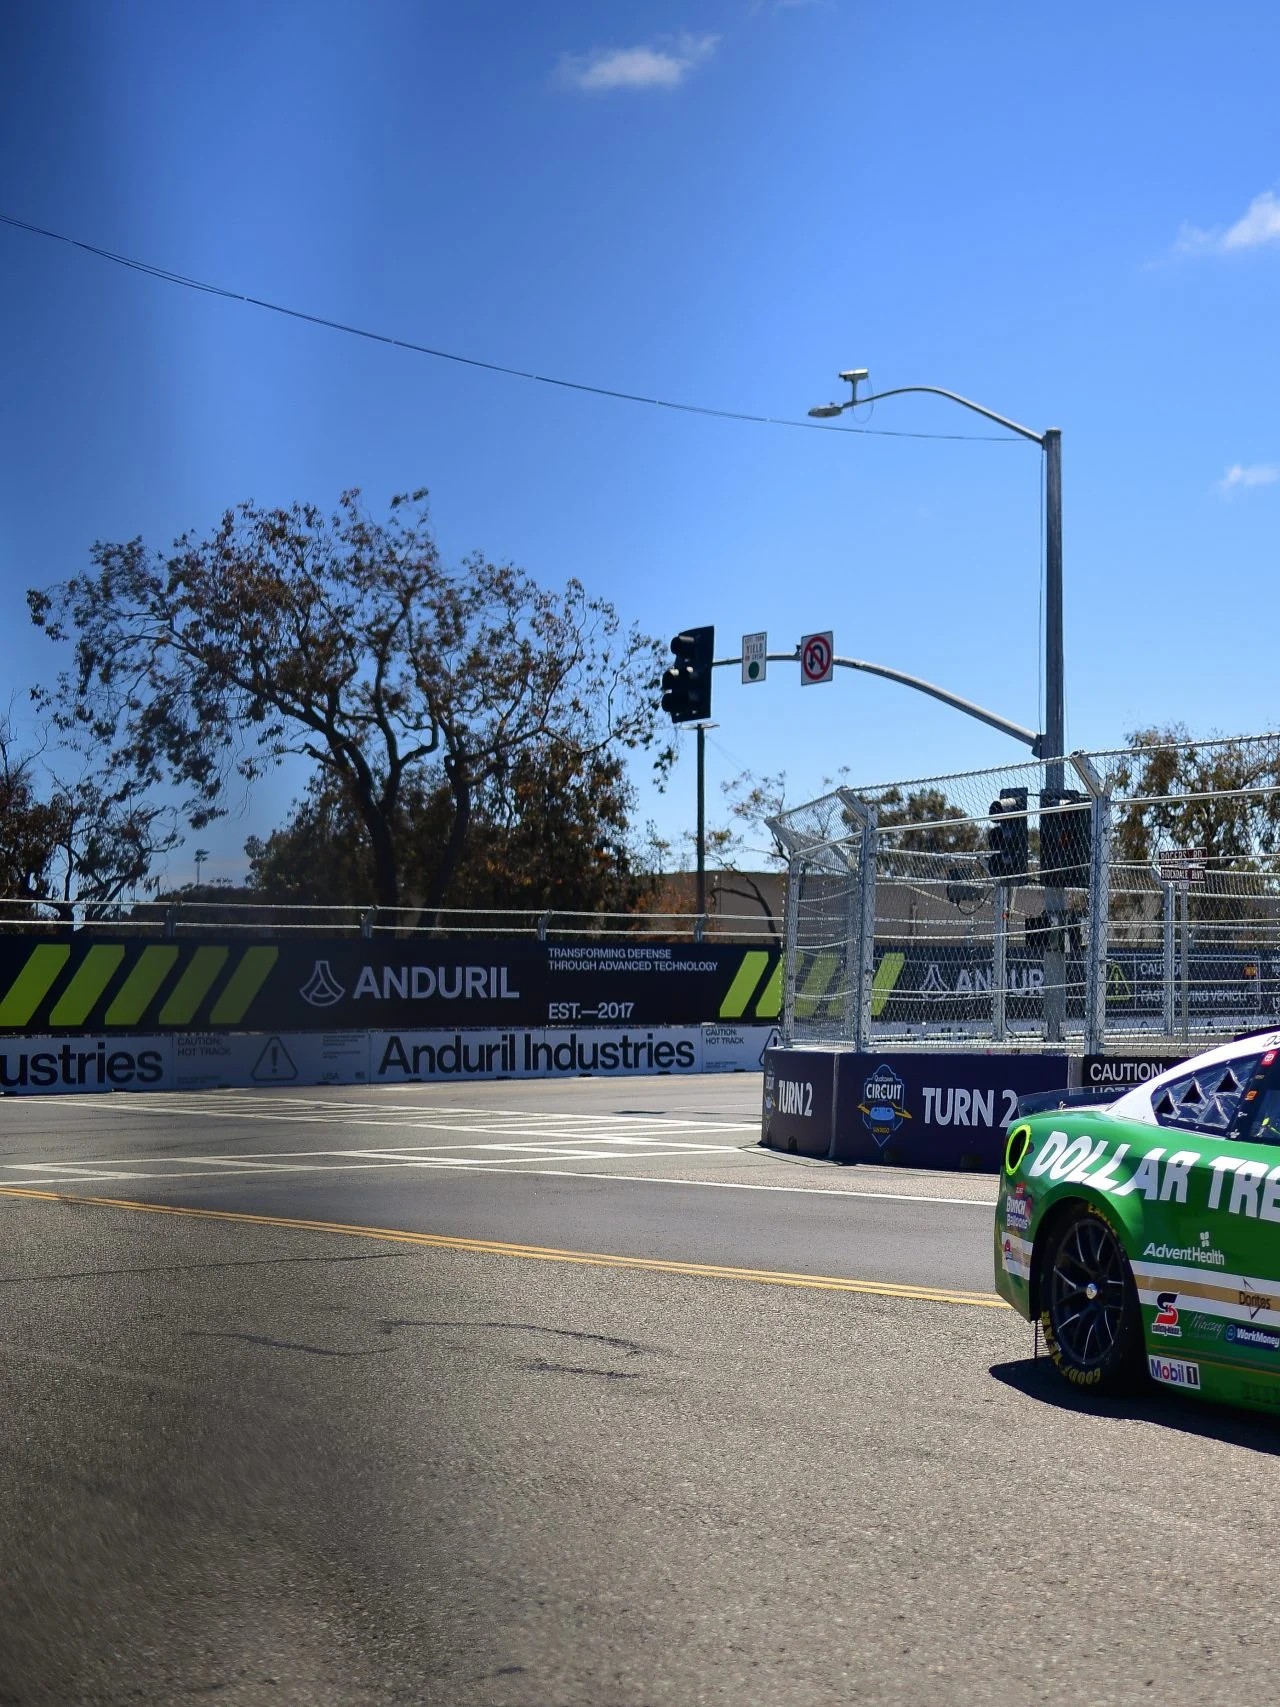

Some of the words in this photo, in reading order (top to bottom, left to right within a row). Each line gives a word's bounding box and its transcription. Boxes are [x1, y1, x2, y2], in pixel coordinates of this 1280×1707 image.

[1162, 869, 1189, 880] STOCKDALE
[548, 948, 626, 958] TRANSFORMING
[628, 949, 672, 959] DEFENSE
[548, 960, 597, 970] THROUGH
[599, 961, 652, 971] ADVANCED
[653, 961, 718, 971] TECHNOLOGY
[353, 965, 520, 999] ANDURIL
[706, 1037, 720, 1045] HOT
[723, 1037, 745, 1045] TRACK
[177, 1047, 197, 1057] HOT
[200, 1047, 232, 1057] TRACK
[378, 1033, 516, 1075] Anduril
[524, 1033, 695, 1072] Industries
[0, 1042, 164, 1086] ustries
[778, 1080, 804, 1116] TURN
[804, 1082, 813, 1117] 2
[866, 1084, 902, 1100] CIRCUIT
[922, 1087, 995, 1127] TURN
[1000, 1089, 1019, 1128] 2
[1029, 1131, 1201, 1203] DOLLAR
[1006, 1195, 1026, 1215] BUNCH
[1143, 1242, 1225, 1266] AdventHealth
[1238, 1291, 1271, 1310] Doritos
[1236, 1328, 1280, 1348] WorkMoney
[1150, 1358, 1185, 1383] Mobil
[1187, 1366, 1198, 1385] 1
